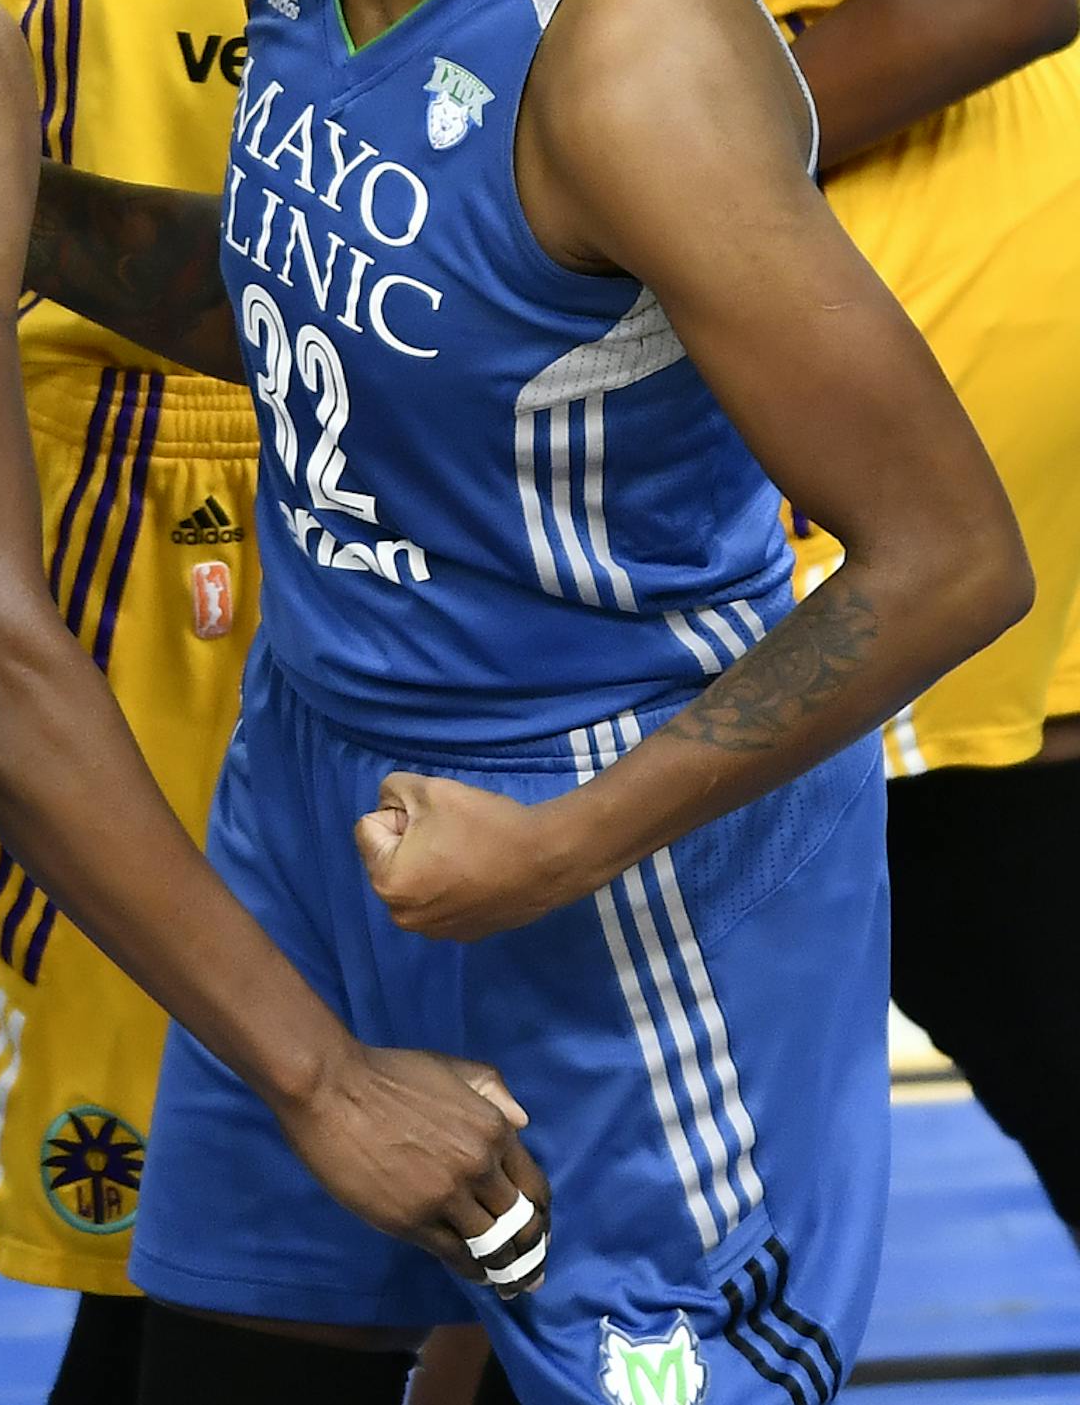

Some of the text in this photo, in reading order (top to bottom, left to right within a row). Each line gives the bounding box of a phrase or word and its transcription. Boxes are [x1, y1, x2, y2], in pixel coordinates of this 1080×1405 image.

[232, 57, 429, 247] MAYO
[222, 164, 443, 359] LINIC
[243, 283, 379, 526] 32
[172, 526, 244, 545] adidas
